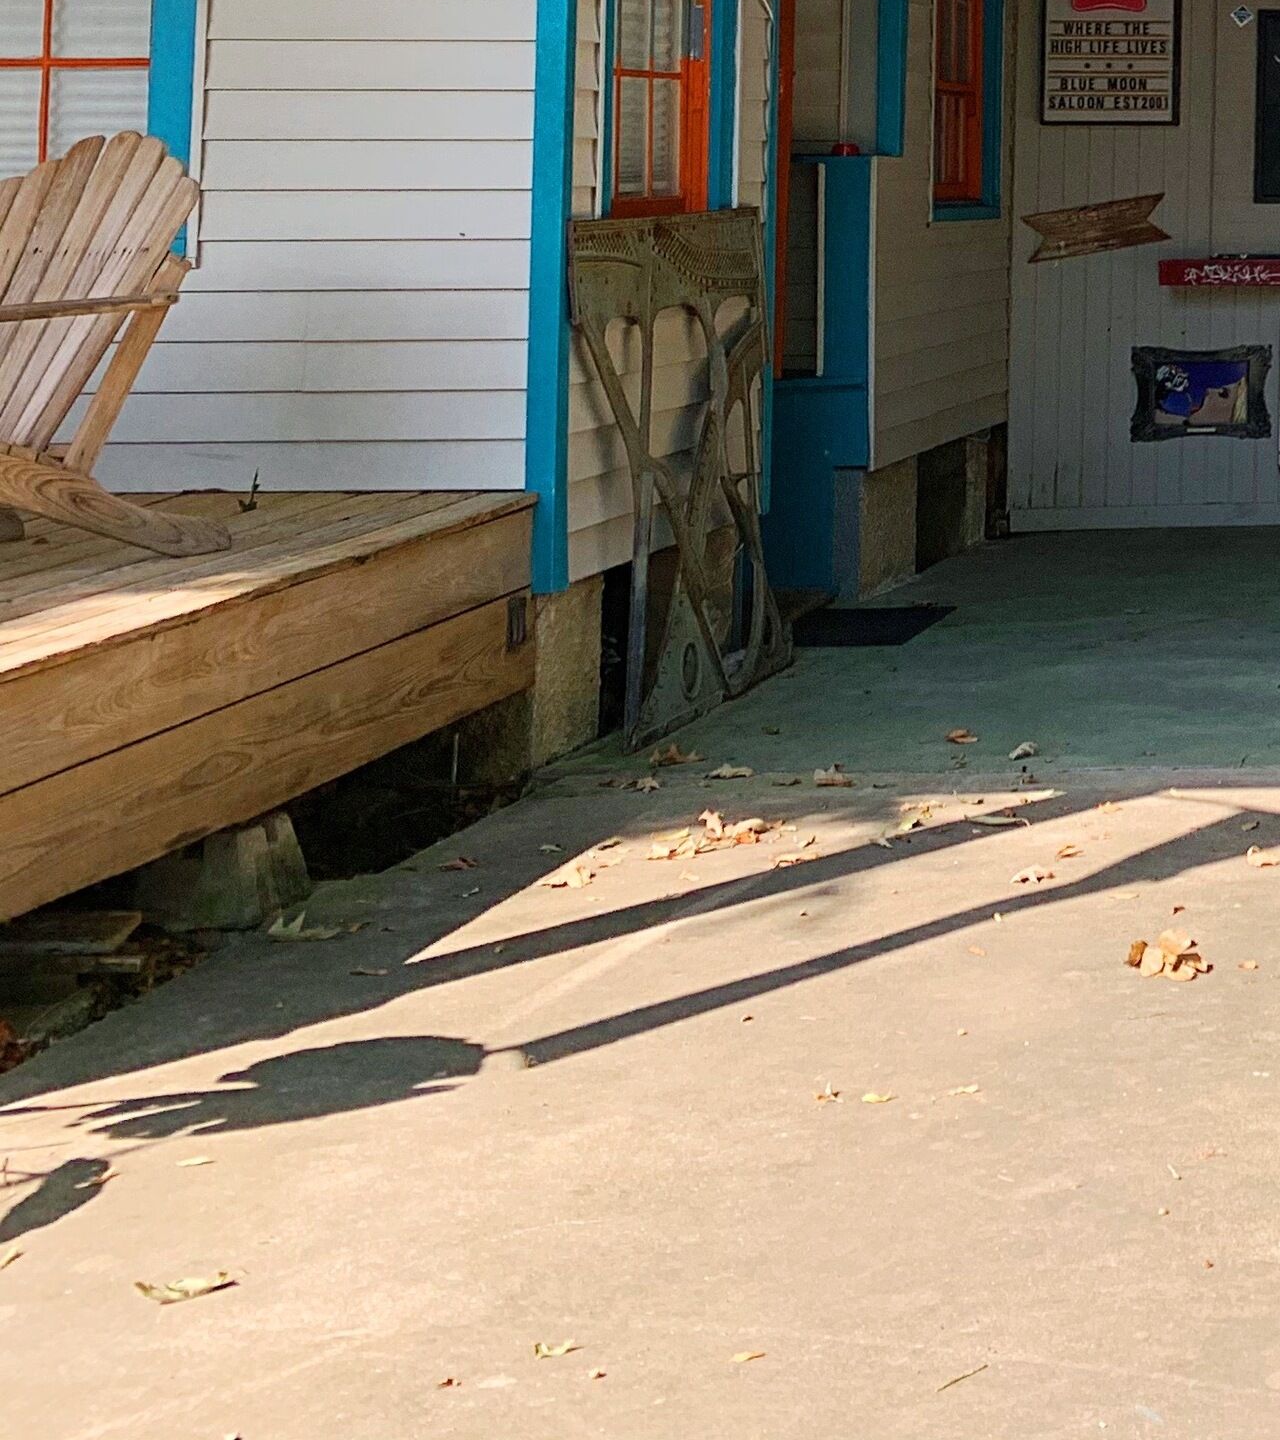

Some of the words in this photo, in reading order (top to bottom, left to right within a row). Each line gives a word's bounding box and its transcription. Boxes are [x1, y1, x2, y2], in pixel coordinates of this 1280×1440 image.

[1063, 23, 1111, 35] WHERE
[1123, 23, 1150, 35] THE
[1051, 41, 1081, 53] HIGH
[1089, 41, 1122, 53] LIFE
[1127, 41, 1166, 53] LIVES
[1060, 78, 1095, 90] BLUE
[1107, 78, 1147, 90] MOON
[1049, 97, 1104, 109] SALOON
